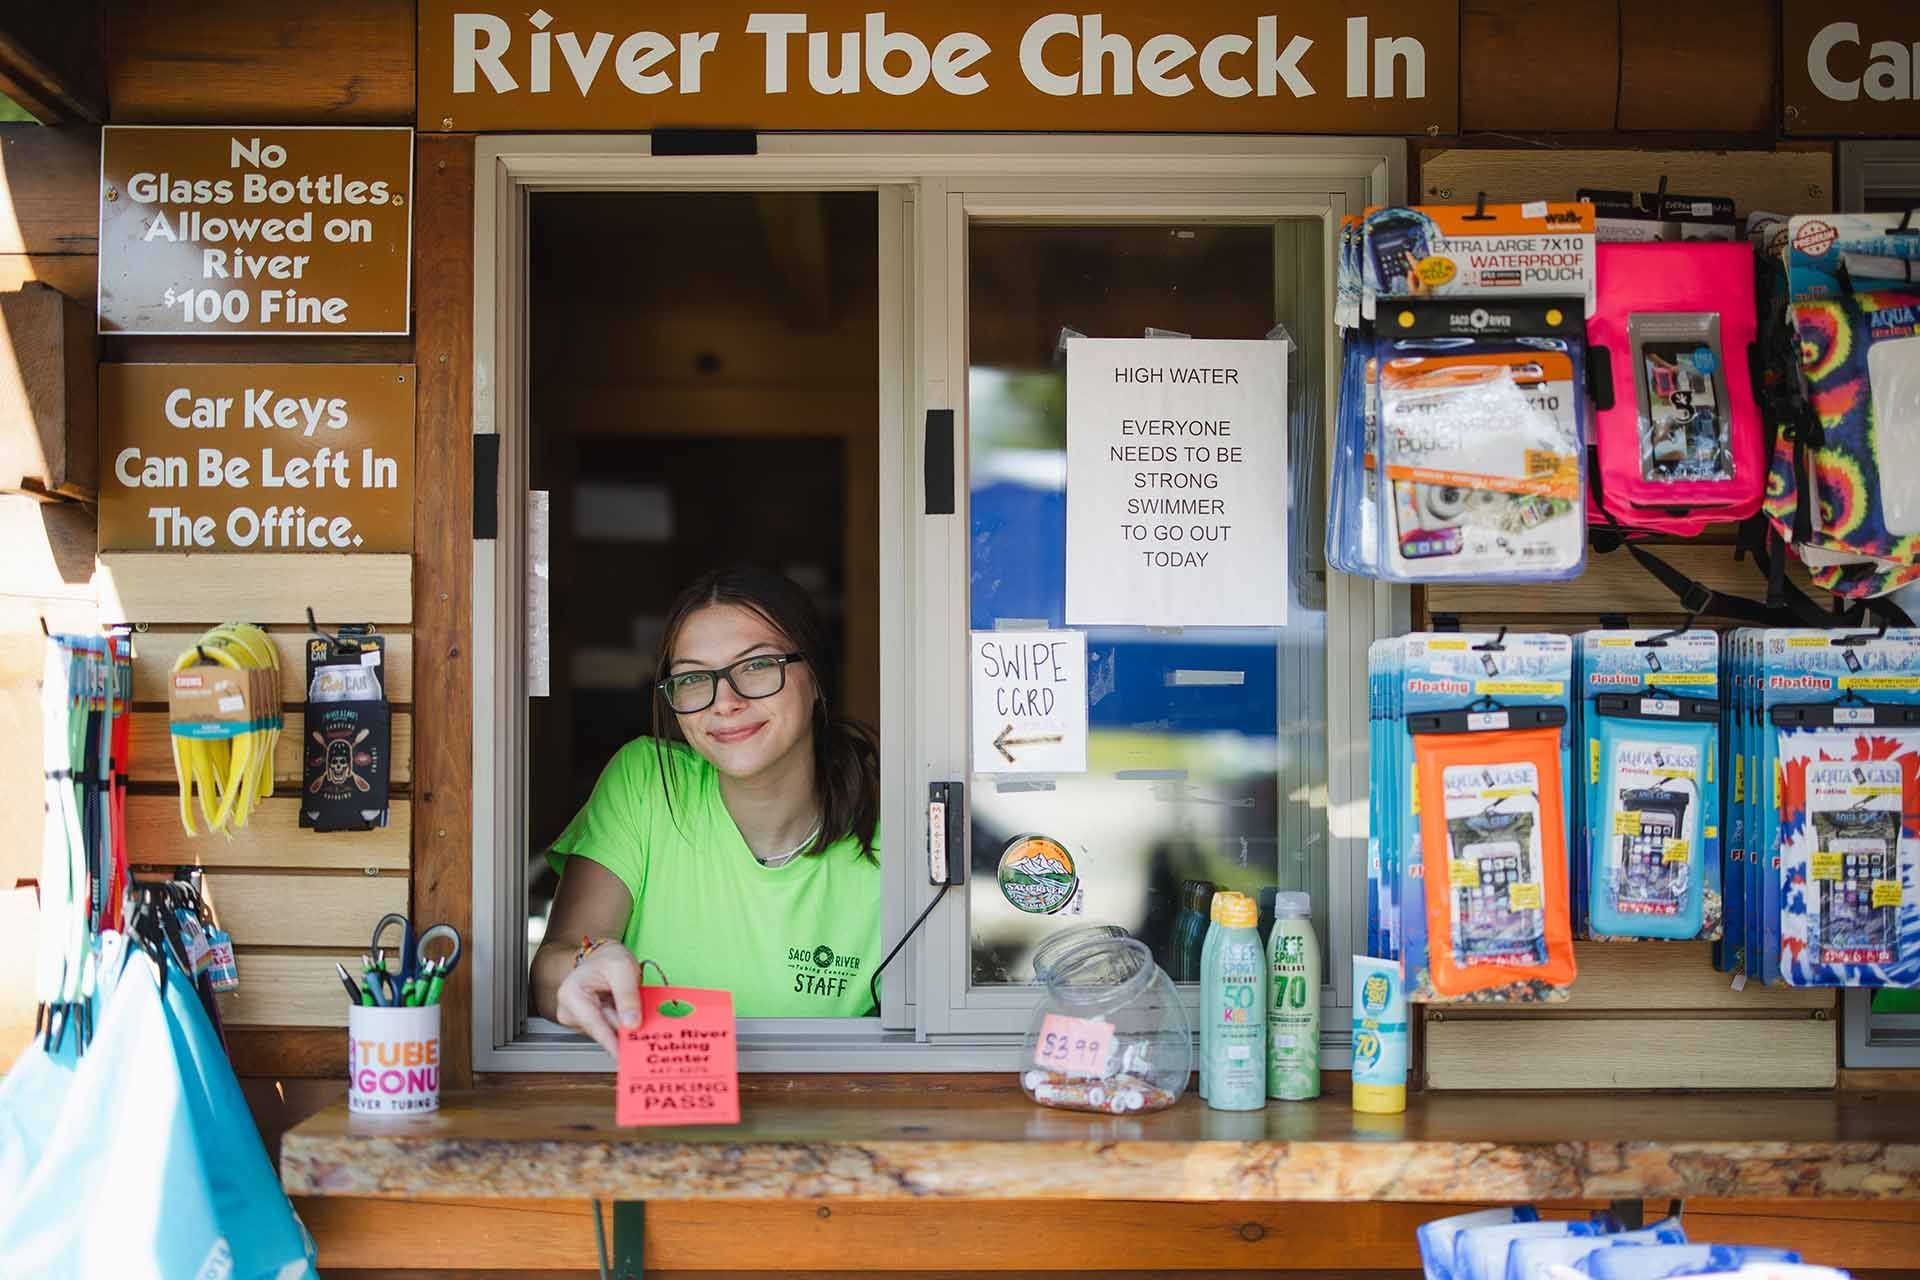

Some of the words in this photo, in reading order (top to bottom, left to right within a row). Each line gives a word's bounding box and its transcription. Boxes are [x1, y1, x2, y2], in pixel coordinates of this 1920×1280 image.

[453, 8, 720, 98] River
[745, 11, 992, 96] Tube
[1019, 12, 1317, 98] Check
[1346, 15, 1426, 99] In
[1807, 21, 1920, 102] Ca
[230, 137, 287, 169] No
[127, 172, 234, 206] Glass
[243, 172, 390, 206] Bottles
[143, 211, 313, 243] Allowed
[323, 217, 373, 243] on
[1432, 239, 1482, 253] EXTRA
[1486, 239, 1537, 252] LARGE
[1542, 238, 1584, 251] 7X10
[202, 247, 310, 281] River
[1470, 253, 1583, 268] WATERPROOF
[1525, 267, 1584, 281] POUCH
[164, 288, 250, 325] $100
[260, 289, 348, 325] Fine
[1115, 367, 1163, 383] HIGH
[1169, 368, 1239, 384] WATER
[164, 387, 234, 429] Car
[243, 386, 349, 437] Keys
[1121, 420, 1232, 436] EVERYONE
[1110, 446, 1177, 462] NEEDS
[1184, 447, 1210, 463] TO
[1217, 447, 1242, 463] BE
[115, 448, 188, 488] Can
[198, 448, 250, 488] Be
[262, 447, 350, 488] Left
[363, 447, 397, 488] In
[1134, 472, 1218, 489] STRONG
[1127, 499, 1225, 515] SWIMMER
[149, 507, 215, 547] The
[226, 506, 363, 547] Office.
[1121, 525, 1147, 541] TO
[1153, 525, 1184, 541] GO
[1190, 525, 1231, 541] OUT
[1143, 551, 1209, 568] TODAY
[980, 641, 1069, 683] SWIPE
[1408, 680, 1469, 694] Floating
[1590, 673, 1639, 685] Floating
[1771, 676, 1831, 690] Floating
[788, 947, 811, 962] SACO
[835, 955, 861, 969] RIVER
[794, 973, 848, 998] STAFF
[1273, 975, 1307, 1009] 70
[1223, 985, 1254, 1009] 50
[628, 1031, 673, 1041] Saco
[680, 1029, 728, 1039] River
[357, 1038, 438, 1068] TUBE
[648, 1042, 710, 1052] Tubing
[1355, 1034, 1378, 1057] 70
[646, 1054, 710, 1064] Center
[630, 1081, 728, 1094] PARKING
[391, 1098, 431, 1110] TUBING
[644, 1095, 715, 1110] PASS
